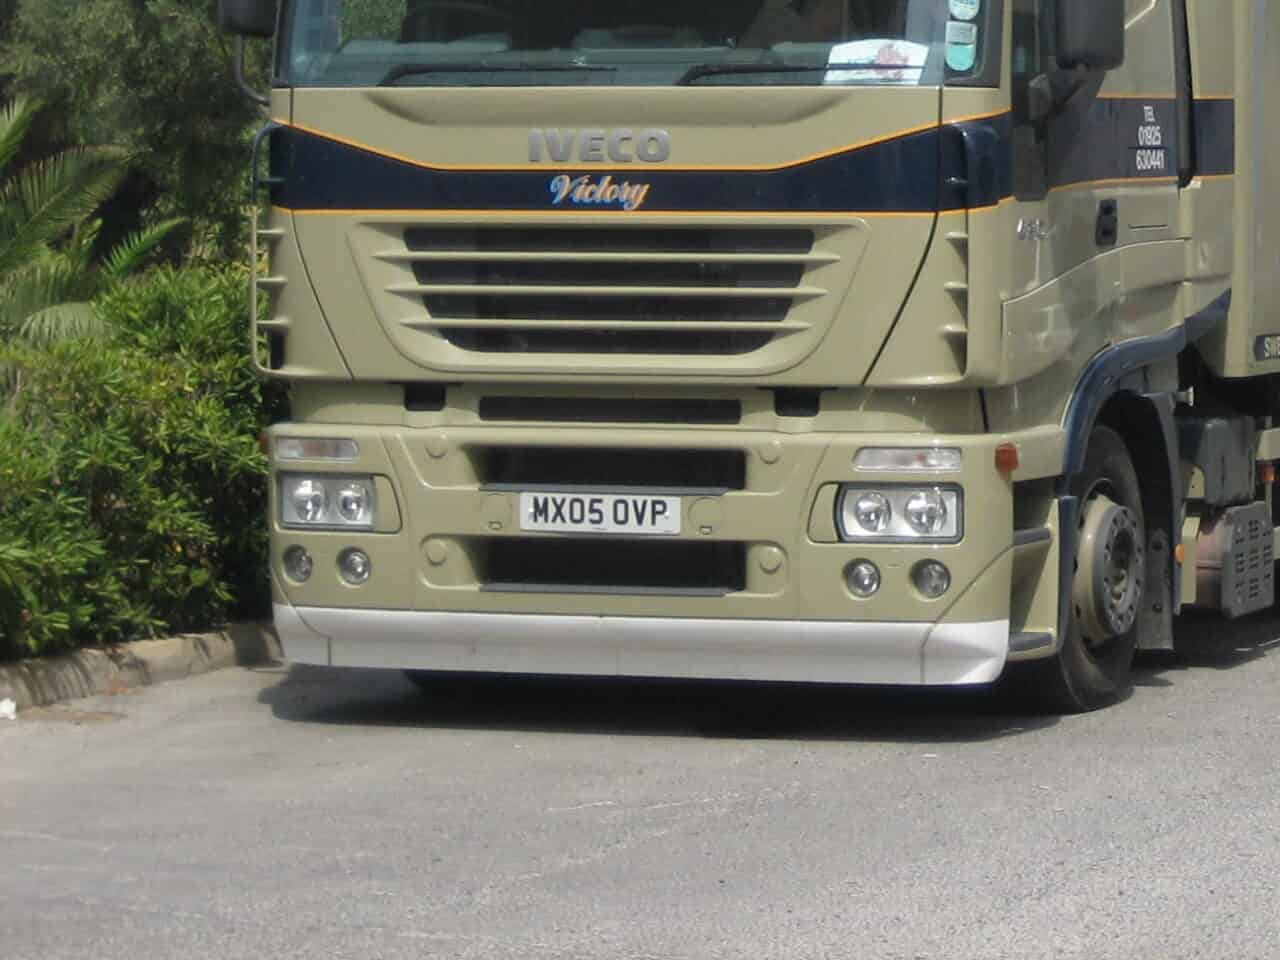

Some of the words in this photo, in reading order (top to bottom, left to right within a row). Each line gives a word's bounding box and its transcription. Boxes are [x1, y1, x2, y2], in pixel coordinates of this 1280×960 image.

[528, 128, 671, 162] IVECO
[549, 174, 651, 211] Victory
[532, 495, 604, 525] MX05
[612, 498, 668, 527] OVP
